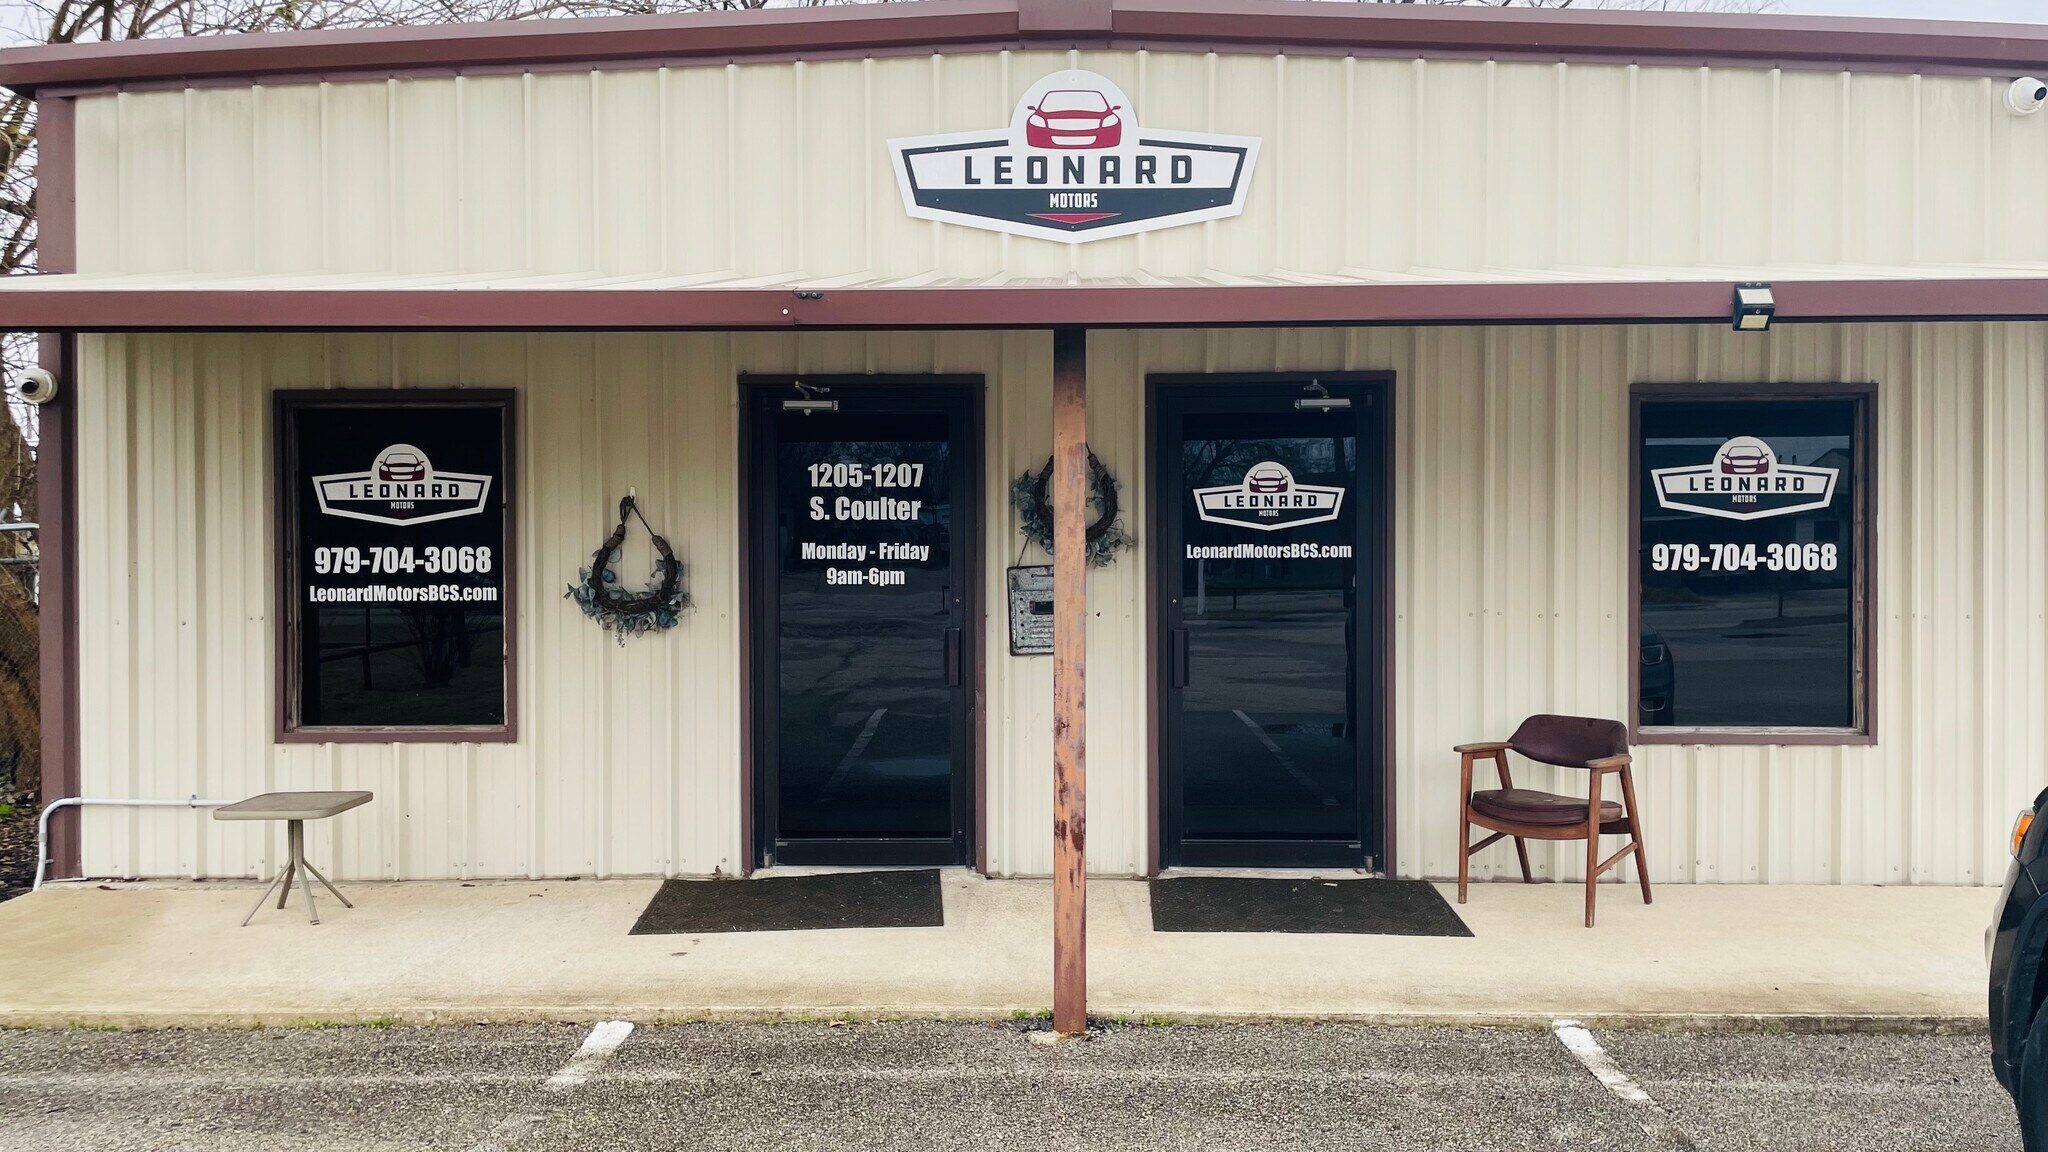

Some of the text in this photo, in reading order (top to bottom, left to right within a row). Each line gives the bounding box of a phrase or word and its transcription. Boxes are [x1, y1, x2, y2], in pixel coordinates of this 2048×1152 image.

[964, 154, 1193, 185] LEONARD
[1049, 193, 1098, 209] MOTORS
[807, 463, 924, 488] 1205-1207
[1689, 476, 1805, 492] LEONARD
[349, 483, 460, 499] LEONARD
[1732, 494, 1757, 503] MOTORS
[390, 501, 415, 510] MOTORS
[810, 495, 922, 521] S. Coulter
[1224, 495, 1318, 508] LEONARD
[1258, 509, 1279, 517] MOTORS
[801, 542, 866, 562] Monday
[879, 542, 930, 562] Friday
[1186, 543, 1352, 559] LeonardMotorsBCS.com
[1651, 543, 1838, 572] 979-704-3068
[314, 546, 492, 574] 979-704-3068
[826, 567, 905, 587] 9am-6pm
[309, 584, 498, 602] LeonardMotorsBCS.com
